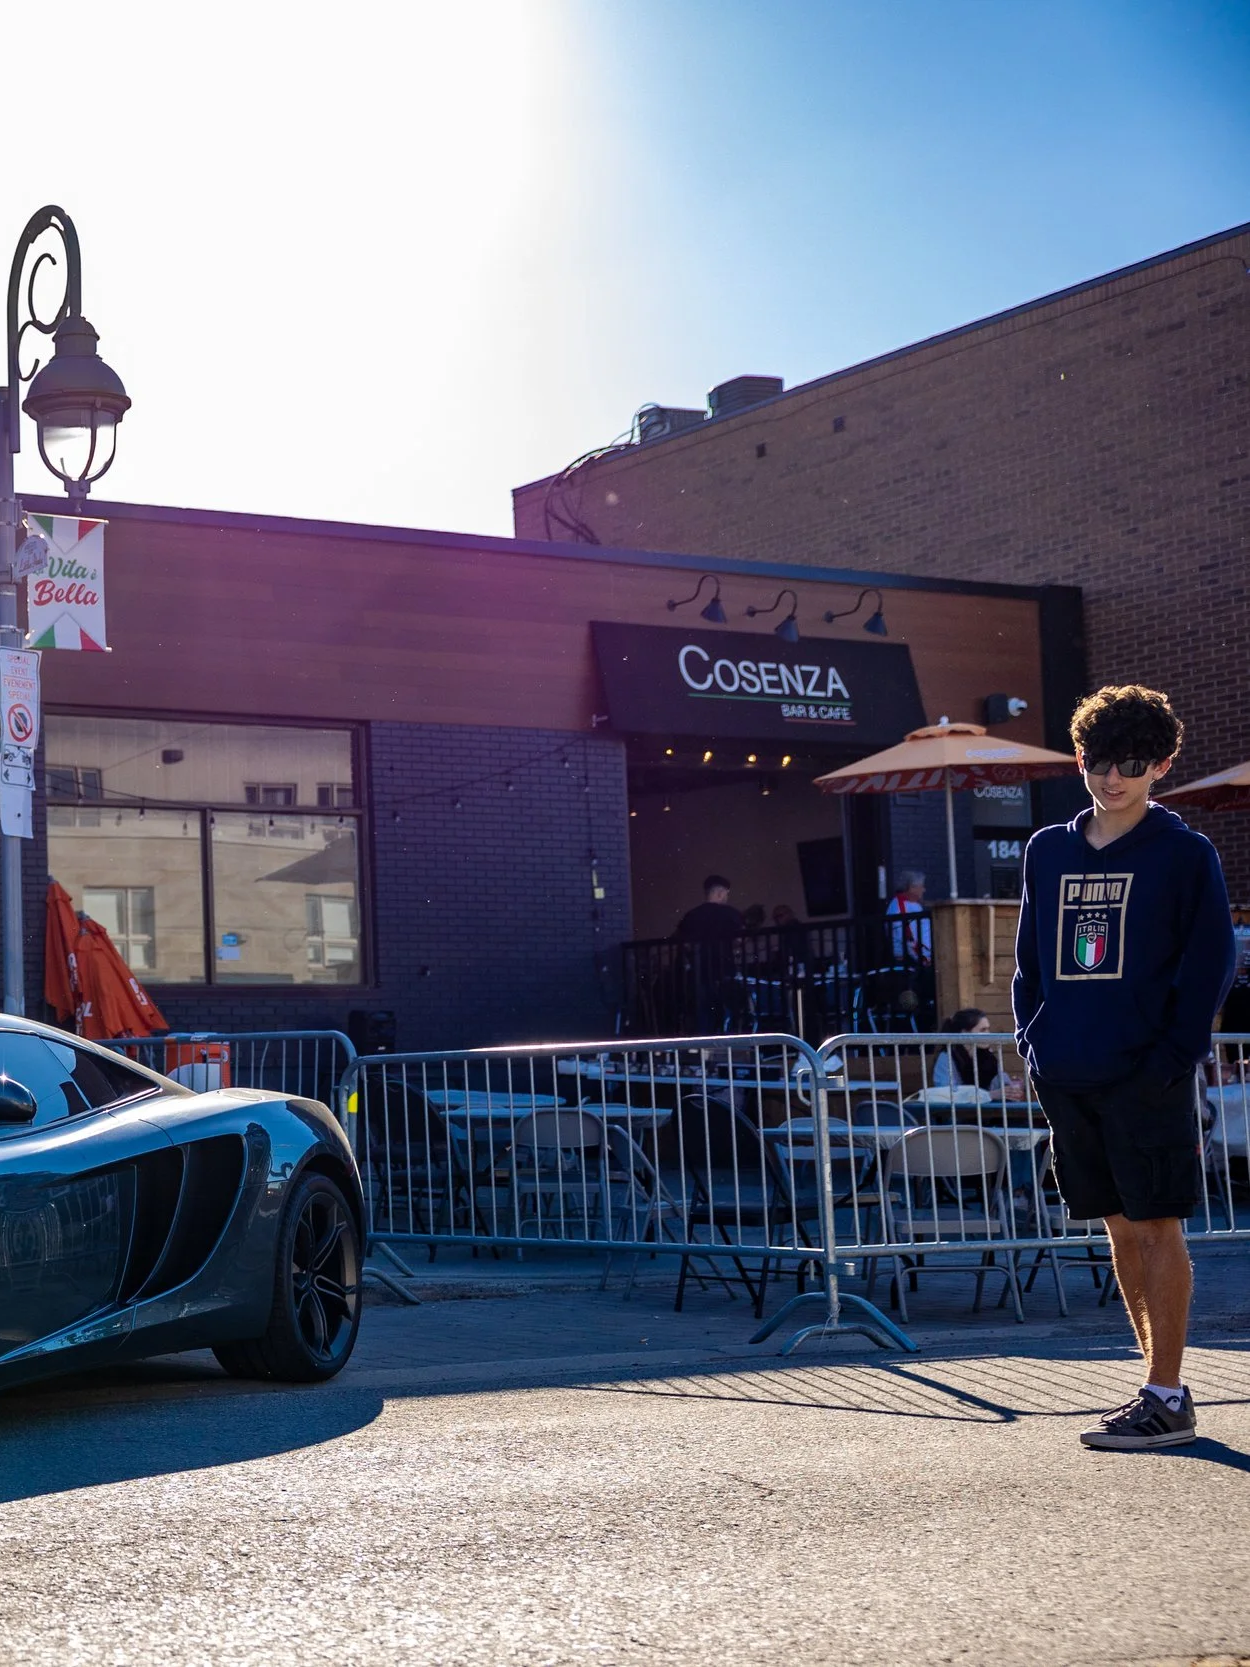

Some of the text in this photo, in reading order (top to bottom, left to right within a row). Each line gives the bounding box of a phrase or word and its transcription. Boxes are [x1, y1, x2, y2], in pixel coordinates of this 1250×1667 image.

[48, 556, 89, 579] Vita
[33, 579, 99, 606] Bella
[678, 644, 850, 699] COSENZA
[781, 703, 852, 721] BAR & CAFE
[987, 839, 1021, 859] 184
[1067, 882, 1123, 902] PUMA
[1078, 925, 1105, 934] ITALIA
